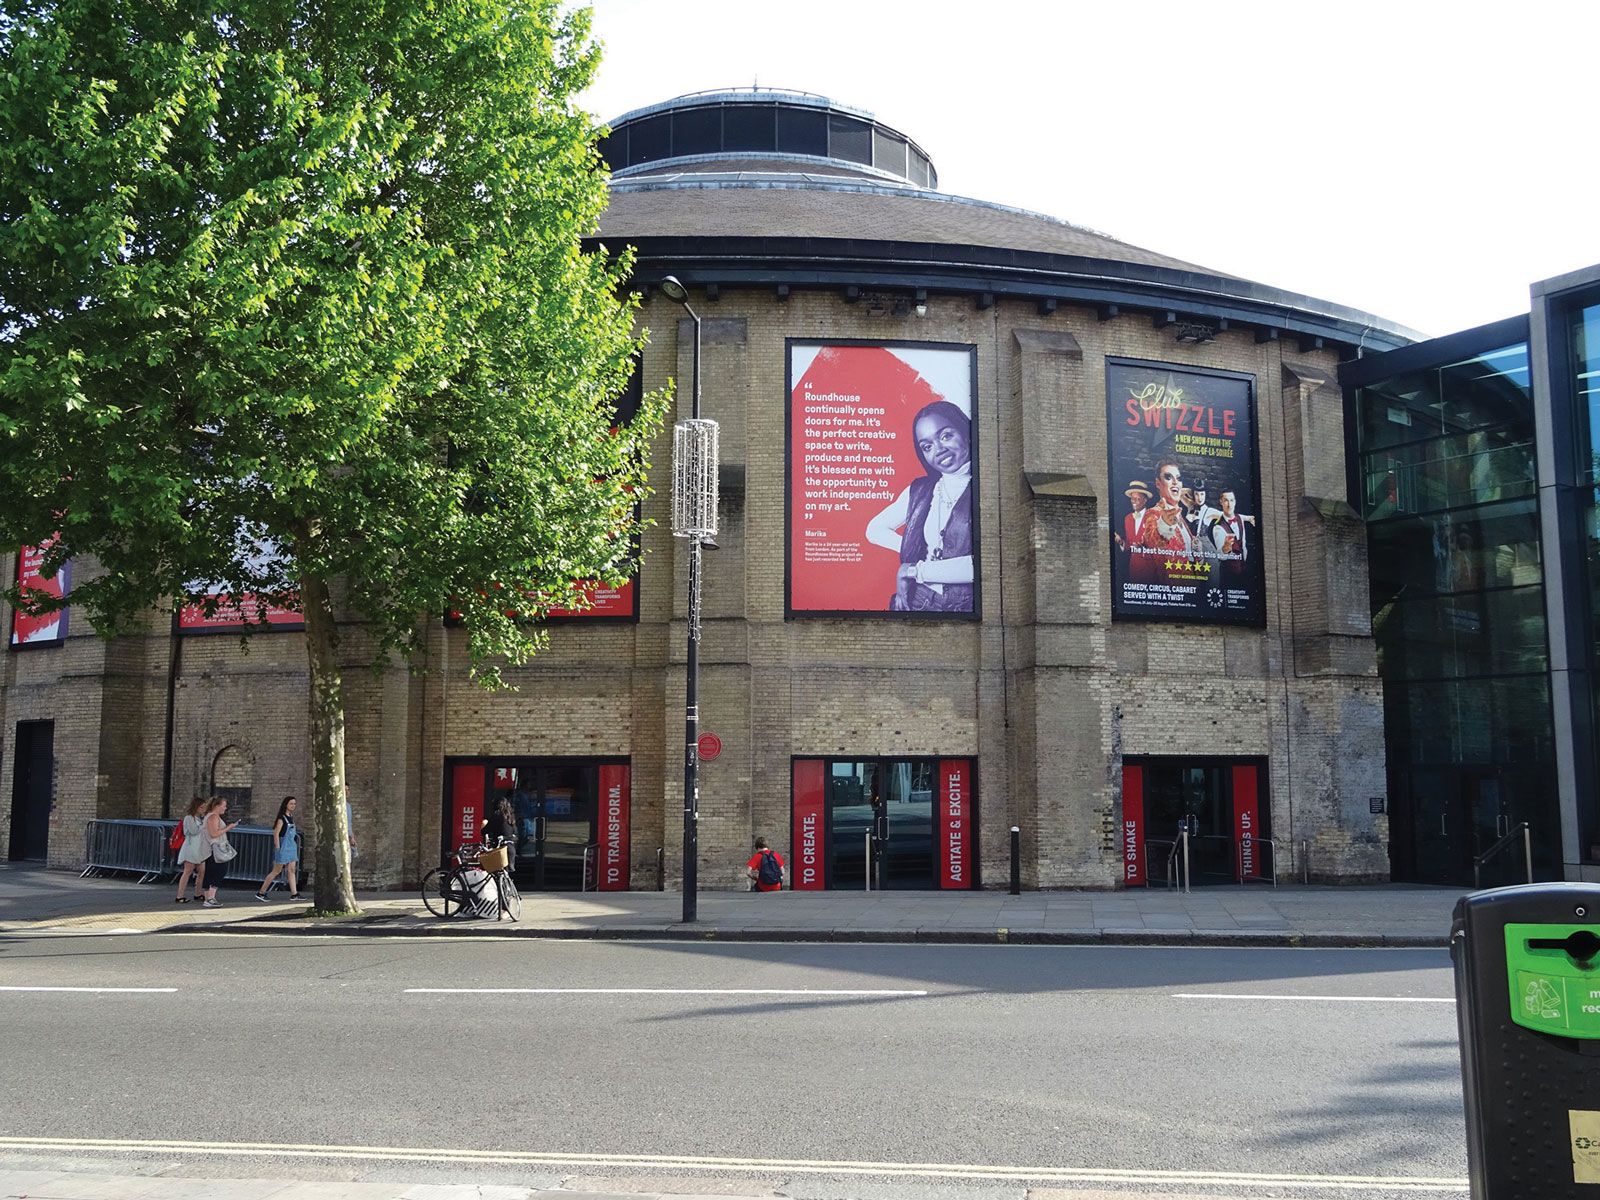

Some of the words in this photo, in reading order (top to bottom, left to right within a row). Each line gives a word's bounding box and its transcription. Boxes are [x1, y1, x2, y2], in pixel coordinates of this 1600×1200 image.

[805, 392, 861, 402] Roundhouse
[805, 405, 856, 416] continually
[857, 407, 885, 416] opens
[805, 417, 831, 425] doors
[832, 417, 846, 426] for
[866, 418, 881, 427] It's
[1126, 399, 1236, 436] SWIZZLE
[805, 428, 821, 437] the
[822, 429, 857, 439] perfect
[858, 430, 896, 439] creative
[805, 443, 832, 451] space
[834, 441, 844, 450] to
[845, 442, 872, 452] write,
[1175, 434, 1180, 442] A
[1180, 434, 1191, 444] NEW
[1192, 436, 1206, 445] SHOW
[1207, 437, 1221, 446] FROM
[1222, 438, 1232, 448] THE
[1175, 444, 1200, 454] CREATORS
[1201, 447, 1207, 455] OF
[1208, 448, 1215, 456] LA
[805, 453, 842, 463] produce
[844, 454, 861, 462] and
[862, 454, 894, 463] record.
[805, 465, 820, 474] It's
[821, 465, 857, 475] blessed
[874, 466, 895, 475] with
[805, 477, 821, 486] the
[822, 478, 877, 488] opportunity
[878, 479, 889, 487] to
[805, 490, 828, 498] work
[830, 490, 895, 501] independently
[818, 504, 832, 512] my
[834, 502, 851, 511] art.
[1158, 548, 1175, 557] boozy
[1176, 549, 1192, 558] night
[1123, 583, 1148, 592] COMEDY,
[1149, 585, 1171, 593] CIRCUS,
[1172, 586, 1197, 594] CABARET
[949, 770, 961, 816] EXCITE.
[462, 806, 474, 839] HERE
[608, 784, 621, 865] TRANSFORM.
[950, 820, 961, 829] &
[1242, 811, 1251, 830] UP.
[803, 812, 817, 864] CREATE,
[1126, 820, 1137, 860] SHAKE
[949, 832, 962, 882] AGITATE
[1242, 832, 1252, 875] THINGS
[608, 868, 619, 884] TO
[803, 865, 815, 884] TO
[1127, 864, 1137, 879] TO
